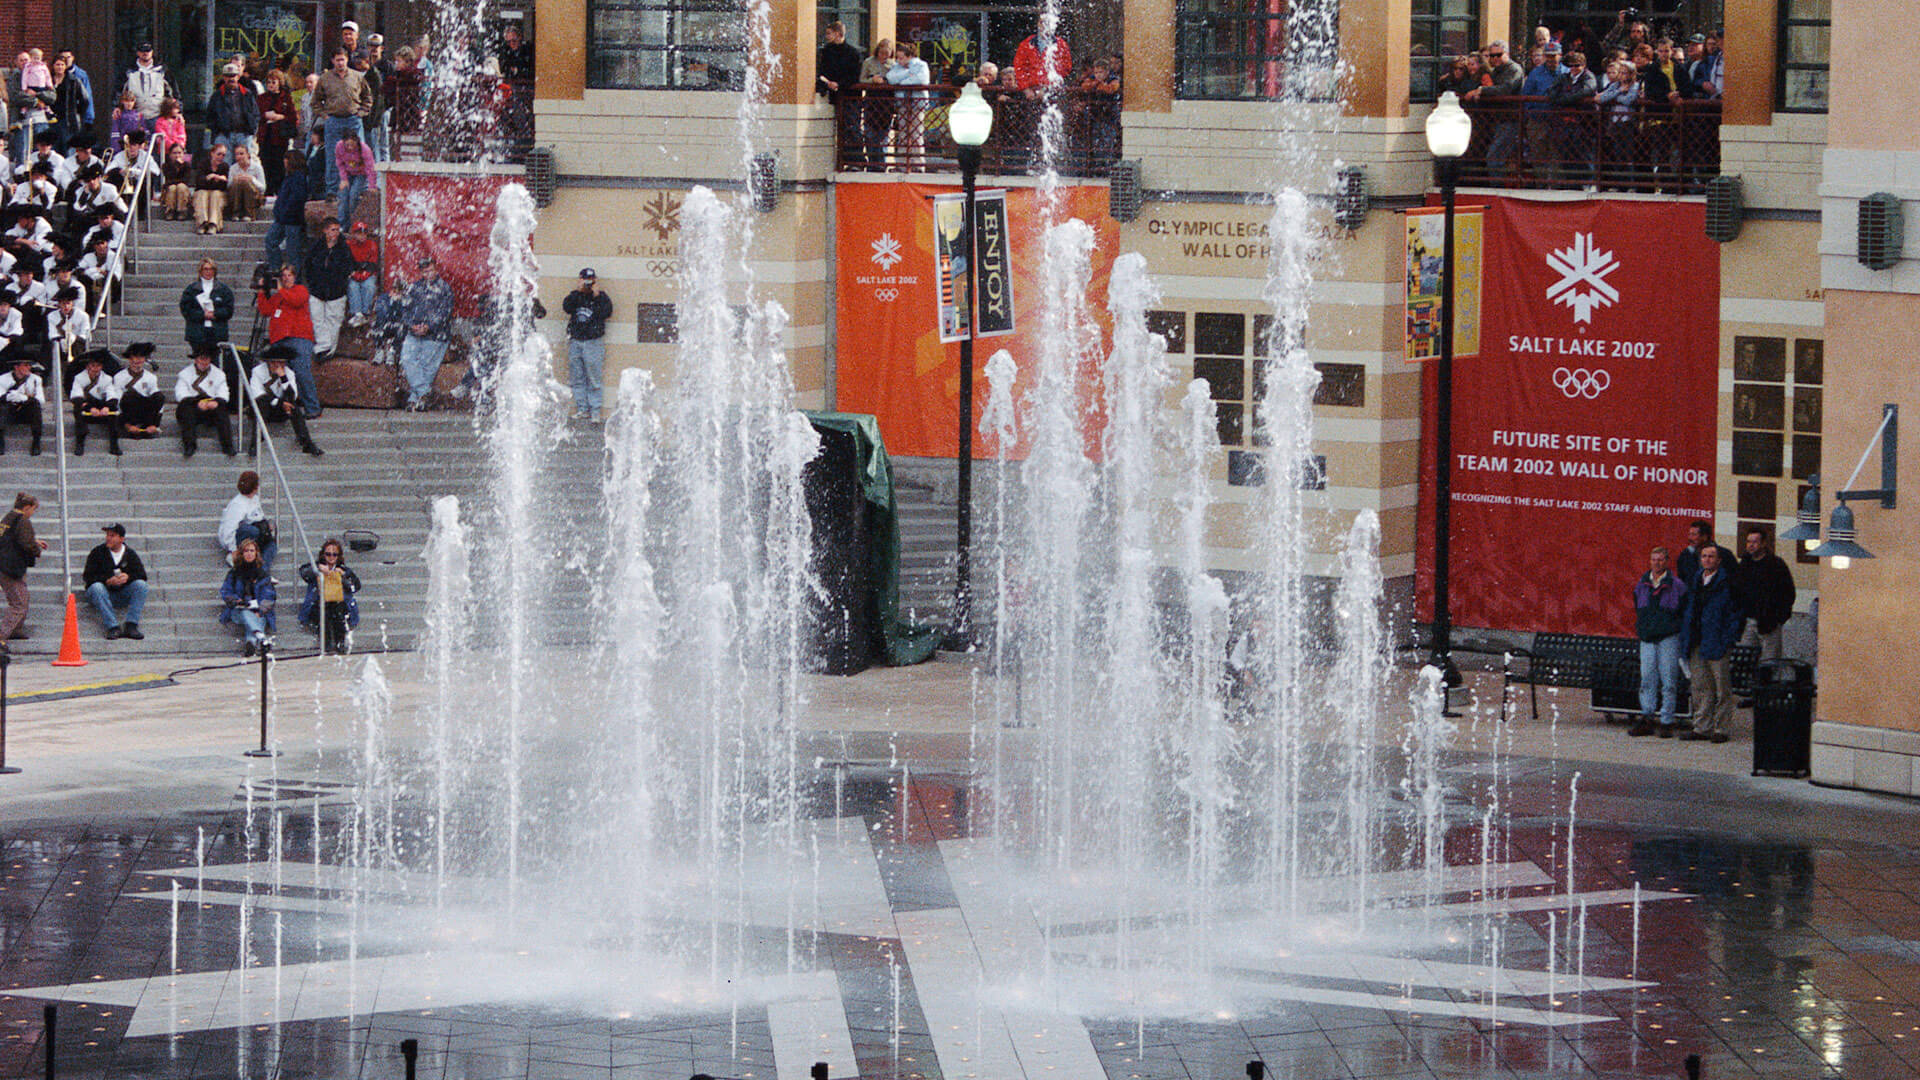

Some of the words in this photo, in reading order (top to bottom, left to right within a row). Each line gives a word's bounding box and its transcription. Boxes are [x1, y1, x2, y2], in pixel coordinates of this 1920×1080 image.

[219, 27, 311, 59] ENJOY
[1149, 219, 1224, 237] OLYMPIC
[616, 245, 646, 256] SALT
[649, 245, 679, 256] LAKE
[1183, 243, 1231, 259] WALL
[1235, 244, 1257, 259] OF
[984, 211, 1005, 319] ENJOY
[856, 275, 875, 285] SALT
[876, 275, 897, 285] LAKE
[898, 275, 918, 285] 2002
[1509, 335, 1554, 353] SALT
[1559, 338, 1606, 356] LAKE
[1611, 341, 1656, 359] 2002
[1493, 430, 1560, 449] FUTURE
[1566, 434, 1601, 452] SITE
[1606, 437, 1631, 453] OF
[1635, 439, 1668, 456] THE
[1457, 454, 1508, 472] TEAM
[1513, 458, 1554, 475] 2002
[1560, 461, 1609, 479] WALL
[1614, 464, 1638, 481] OF
[1643, 466, 1708, 486] HONOR
[1451, 492, 1512, 505] RECOGNIZING
[1514, 496, 1530, 506] THE
[1533, 497, 1554, 508] SALT
[1557, 499, 1580, 510] LAKE
[1582, 501, 1602, 511] 2002
[1605, 502, 1630, 513] STAFF
[1633, 504, 1653, 515] AND
[1655, 506, 1713, 519] VOLUNTEERS
